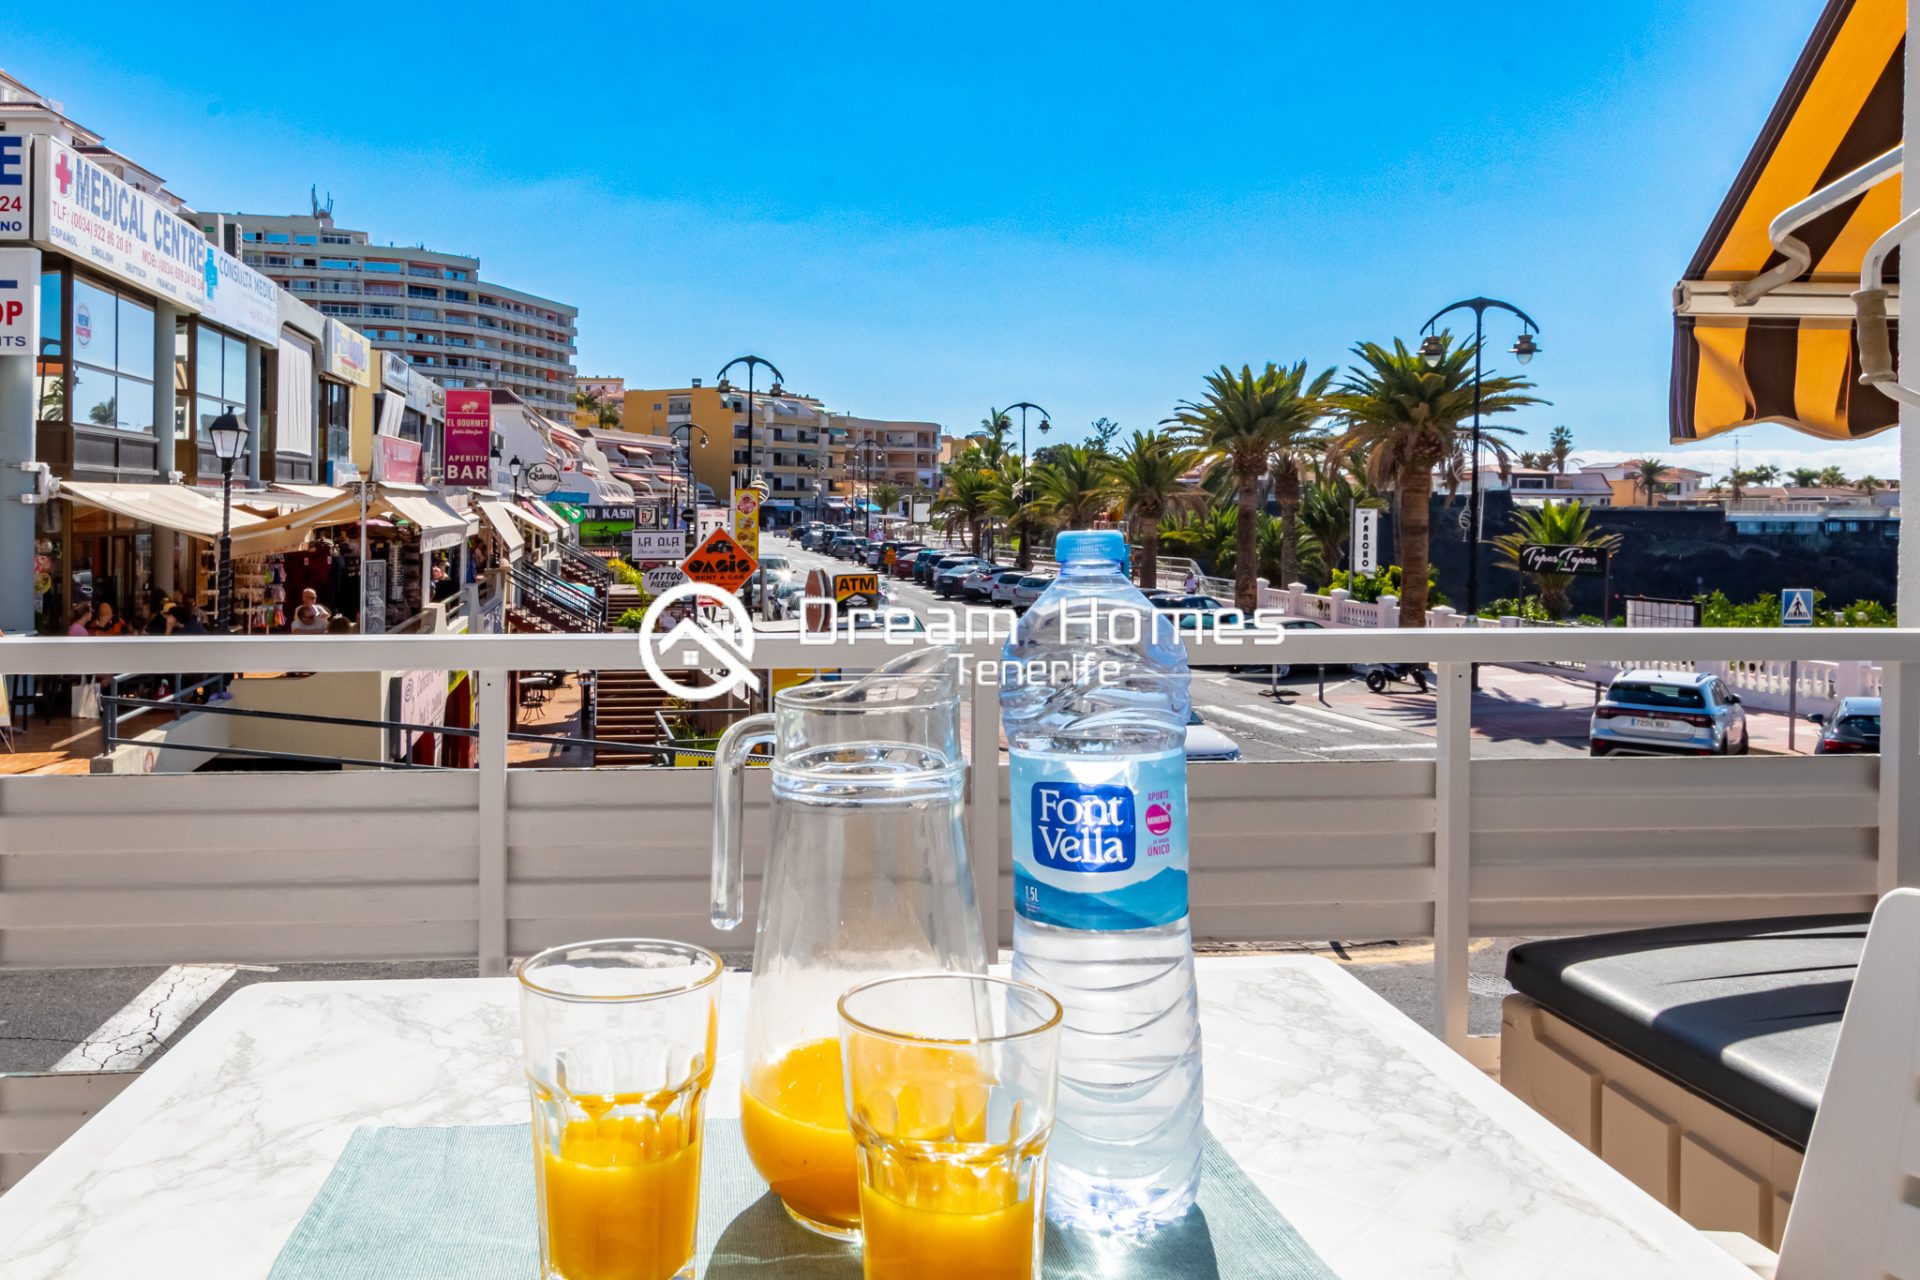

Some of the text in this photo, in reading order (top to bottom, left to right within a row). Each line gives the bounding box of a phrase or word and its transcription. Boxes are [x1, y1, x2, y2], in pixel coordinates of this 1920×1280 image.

[75, 158, 147, 243] MEDICAL
[154, 209, 204, 274] CENTRE
[0, 221, 22, 231] NO
[71, 212, 93, 238] (0034)
[94, 223, 106, 242] 922
[116, 234, 124, 252] 20
[91, 245, 114, 263] ENGLISH
[219, 256, 252, 289] CONSULTA
[0, 336, 26, 347] TS
[446, 418, 489, 428] EL GOURMET
[447, 464, 487, 480] BAR
[529, 472, 558, 481] Quinta
[638, 537, 680, 547] LA OLA
[1362, 515, 1370, 567] PANCHO
[1522, 546, 1559, 570] Tapas
[1558, 547, 1598, 572] Tapas
[648, 571, 683, 580] TATTOO
[838, 577, 875, 591] ATM
[1147, 790, 1169, 801] APORTE
[1039, 788, 1124, 826] Font
[1147, 814, 1170, 825] MINERAL
[1038, 825, 1128, 864] Vella
